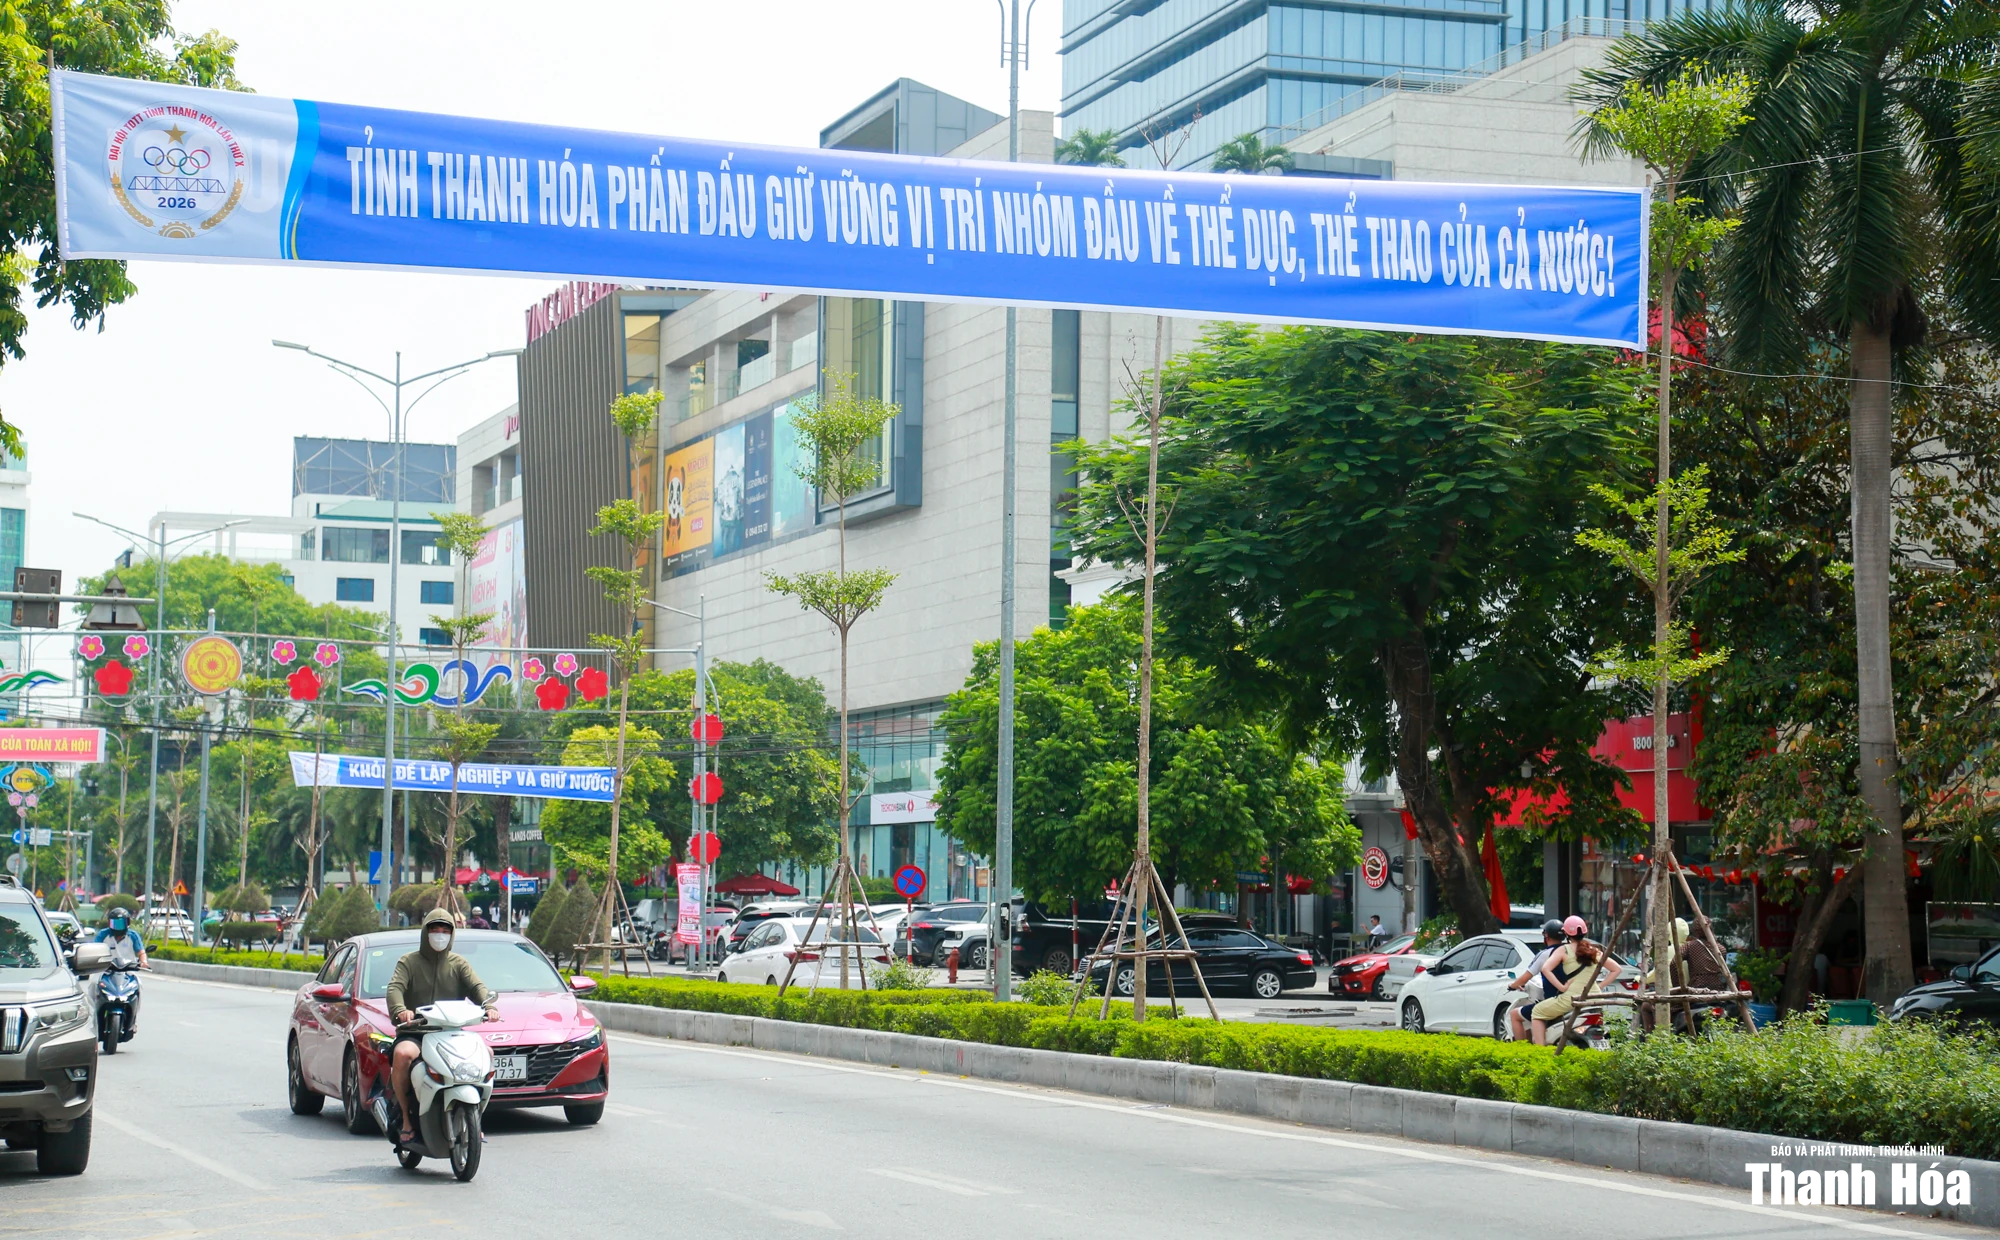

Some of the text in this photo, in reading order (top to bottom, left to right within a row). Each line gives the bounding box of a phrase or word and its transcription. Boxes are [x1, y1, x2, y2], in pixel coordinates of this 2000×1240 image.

[143, 106, 165, 119] TỈNH
[166, 105, 199, 120] THANH
[198, 112, 218, 130] HÓA
[123, 112, 144, 131] TDTT
[113, 128, 128, 145] HỘI
[108, 144, 121, 161] ĐẠI
[228, 140, 245, 159] THỨ
[234, 160, 245, 168] X
[157, 196, 197, 209] 2026
[346, 125, 1616, 298] TỈNH THANH HÓA PHẤN ĐẤU GIỮ VỮNG VỊ TRÍ NHÓM ĐẦU VỀ THỂ DỤC, THỂ THAO CỦA CẢ NƯỚC!
[525, 281, 575, 344] VINCOM
[1, 734, 92, 755] CỦA TOÀN XÃ HỘI!
[1632, 736, 1652, 750] 1800
[420, 764, 450, 785] LẬP
[457, 768, 512, 789] NGHIỆP
[515, 769, 537, 788] VÀ
[540, 771, 567, 789] GIỮ
[569, 773, 615, 793] NƯỚC!
[494, 1057, 514, 1068] 36A
